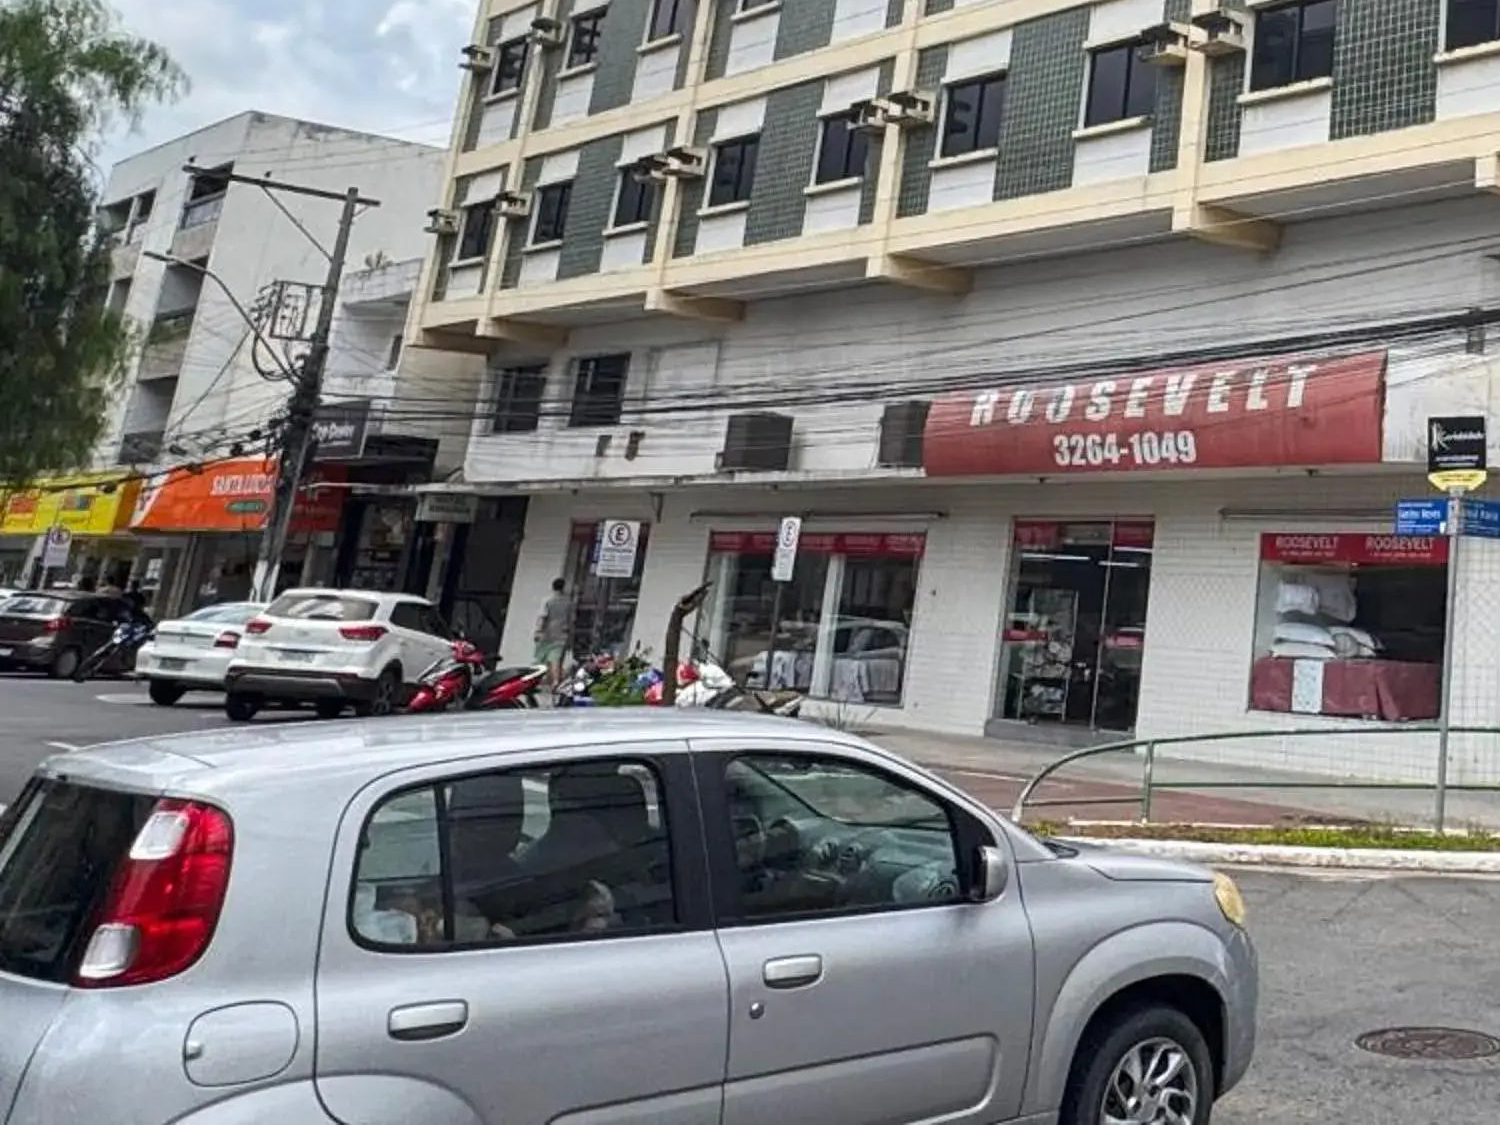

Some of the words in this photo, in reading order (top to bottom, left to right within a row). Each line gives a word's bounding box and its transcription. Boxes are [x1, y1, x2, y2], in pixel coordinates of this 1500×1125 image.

[969, 364, 1317, 427] ROOSEVELT
[1053, 430, 1197, 467] 3264-1049
[1275, 536, 1340, 551] ROOSEVELT
[1365, 536, 1435, 551] ROOSEVELT
